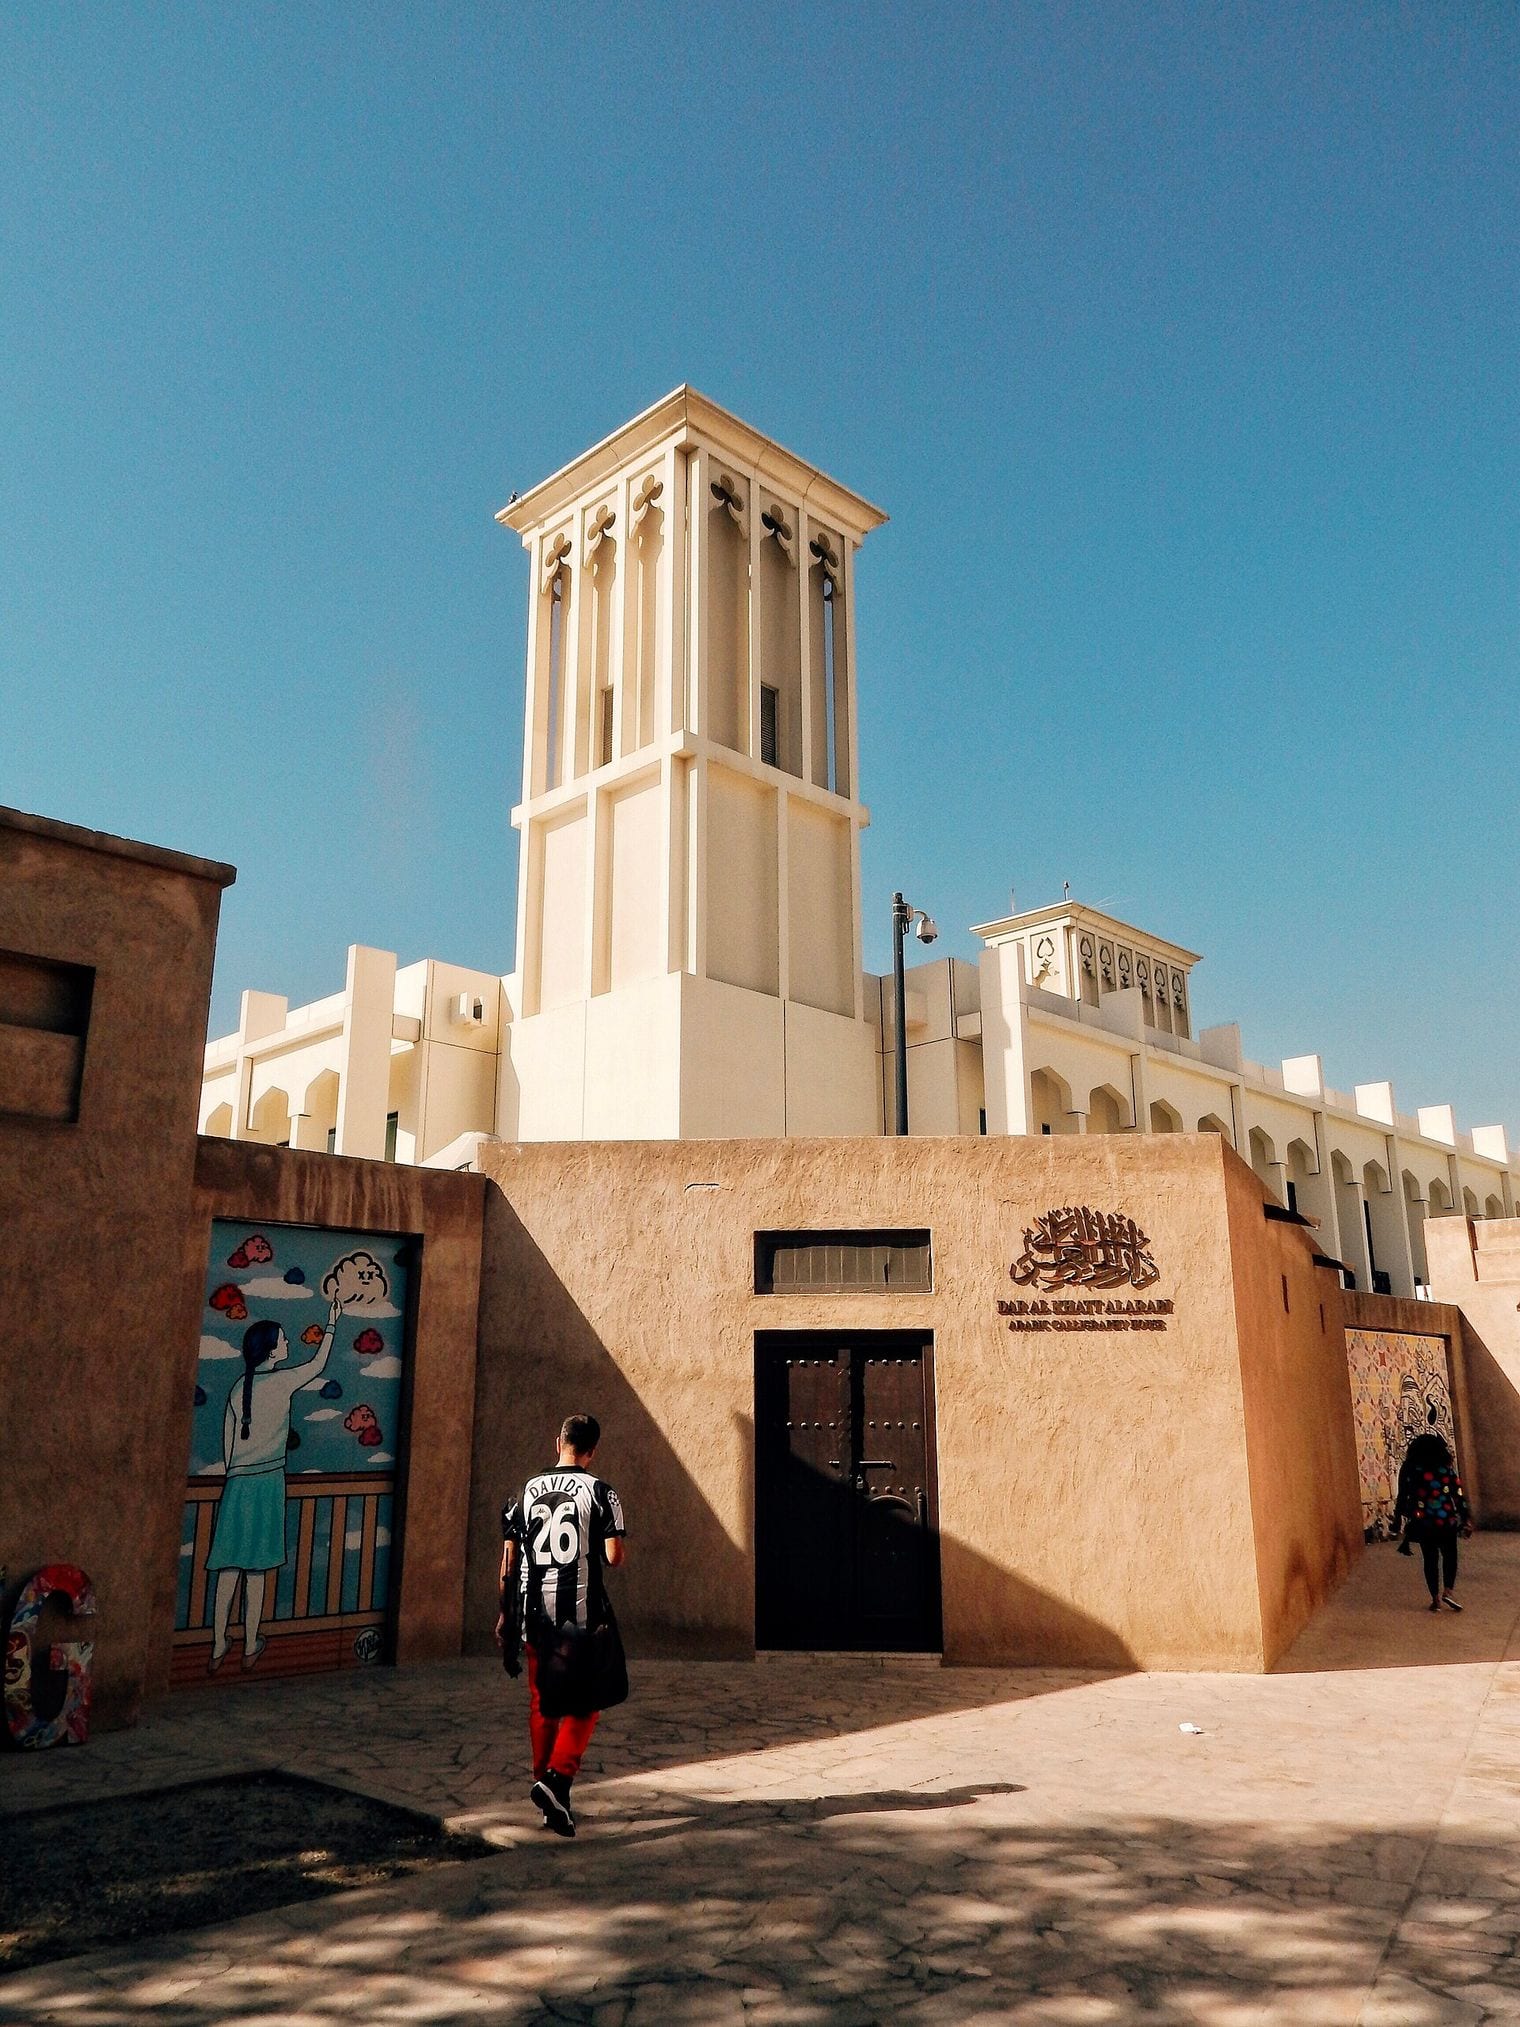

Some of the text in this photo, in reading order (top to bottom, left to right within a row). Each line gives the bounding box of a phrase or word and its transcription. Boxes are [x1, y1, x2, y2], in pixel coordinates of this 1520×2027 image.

[1008, 1320, 1052, 1332] ARABIC
[1052, 1320, 1130, 1332] CALLIGRAPHY
[529, 1476, 582, 1498] DAVIDS
[531, 1501, 579, 1565] 26
